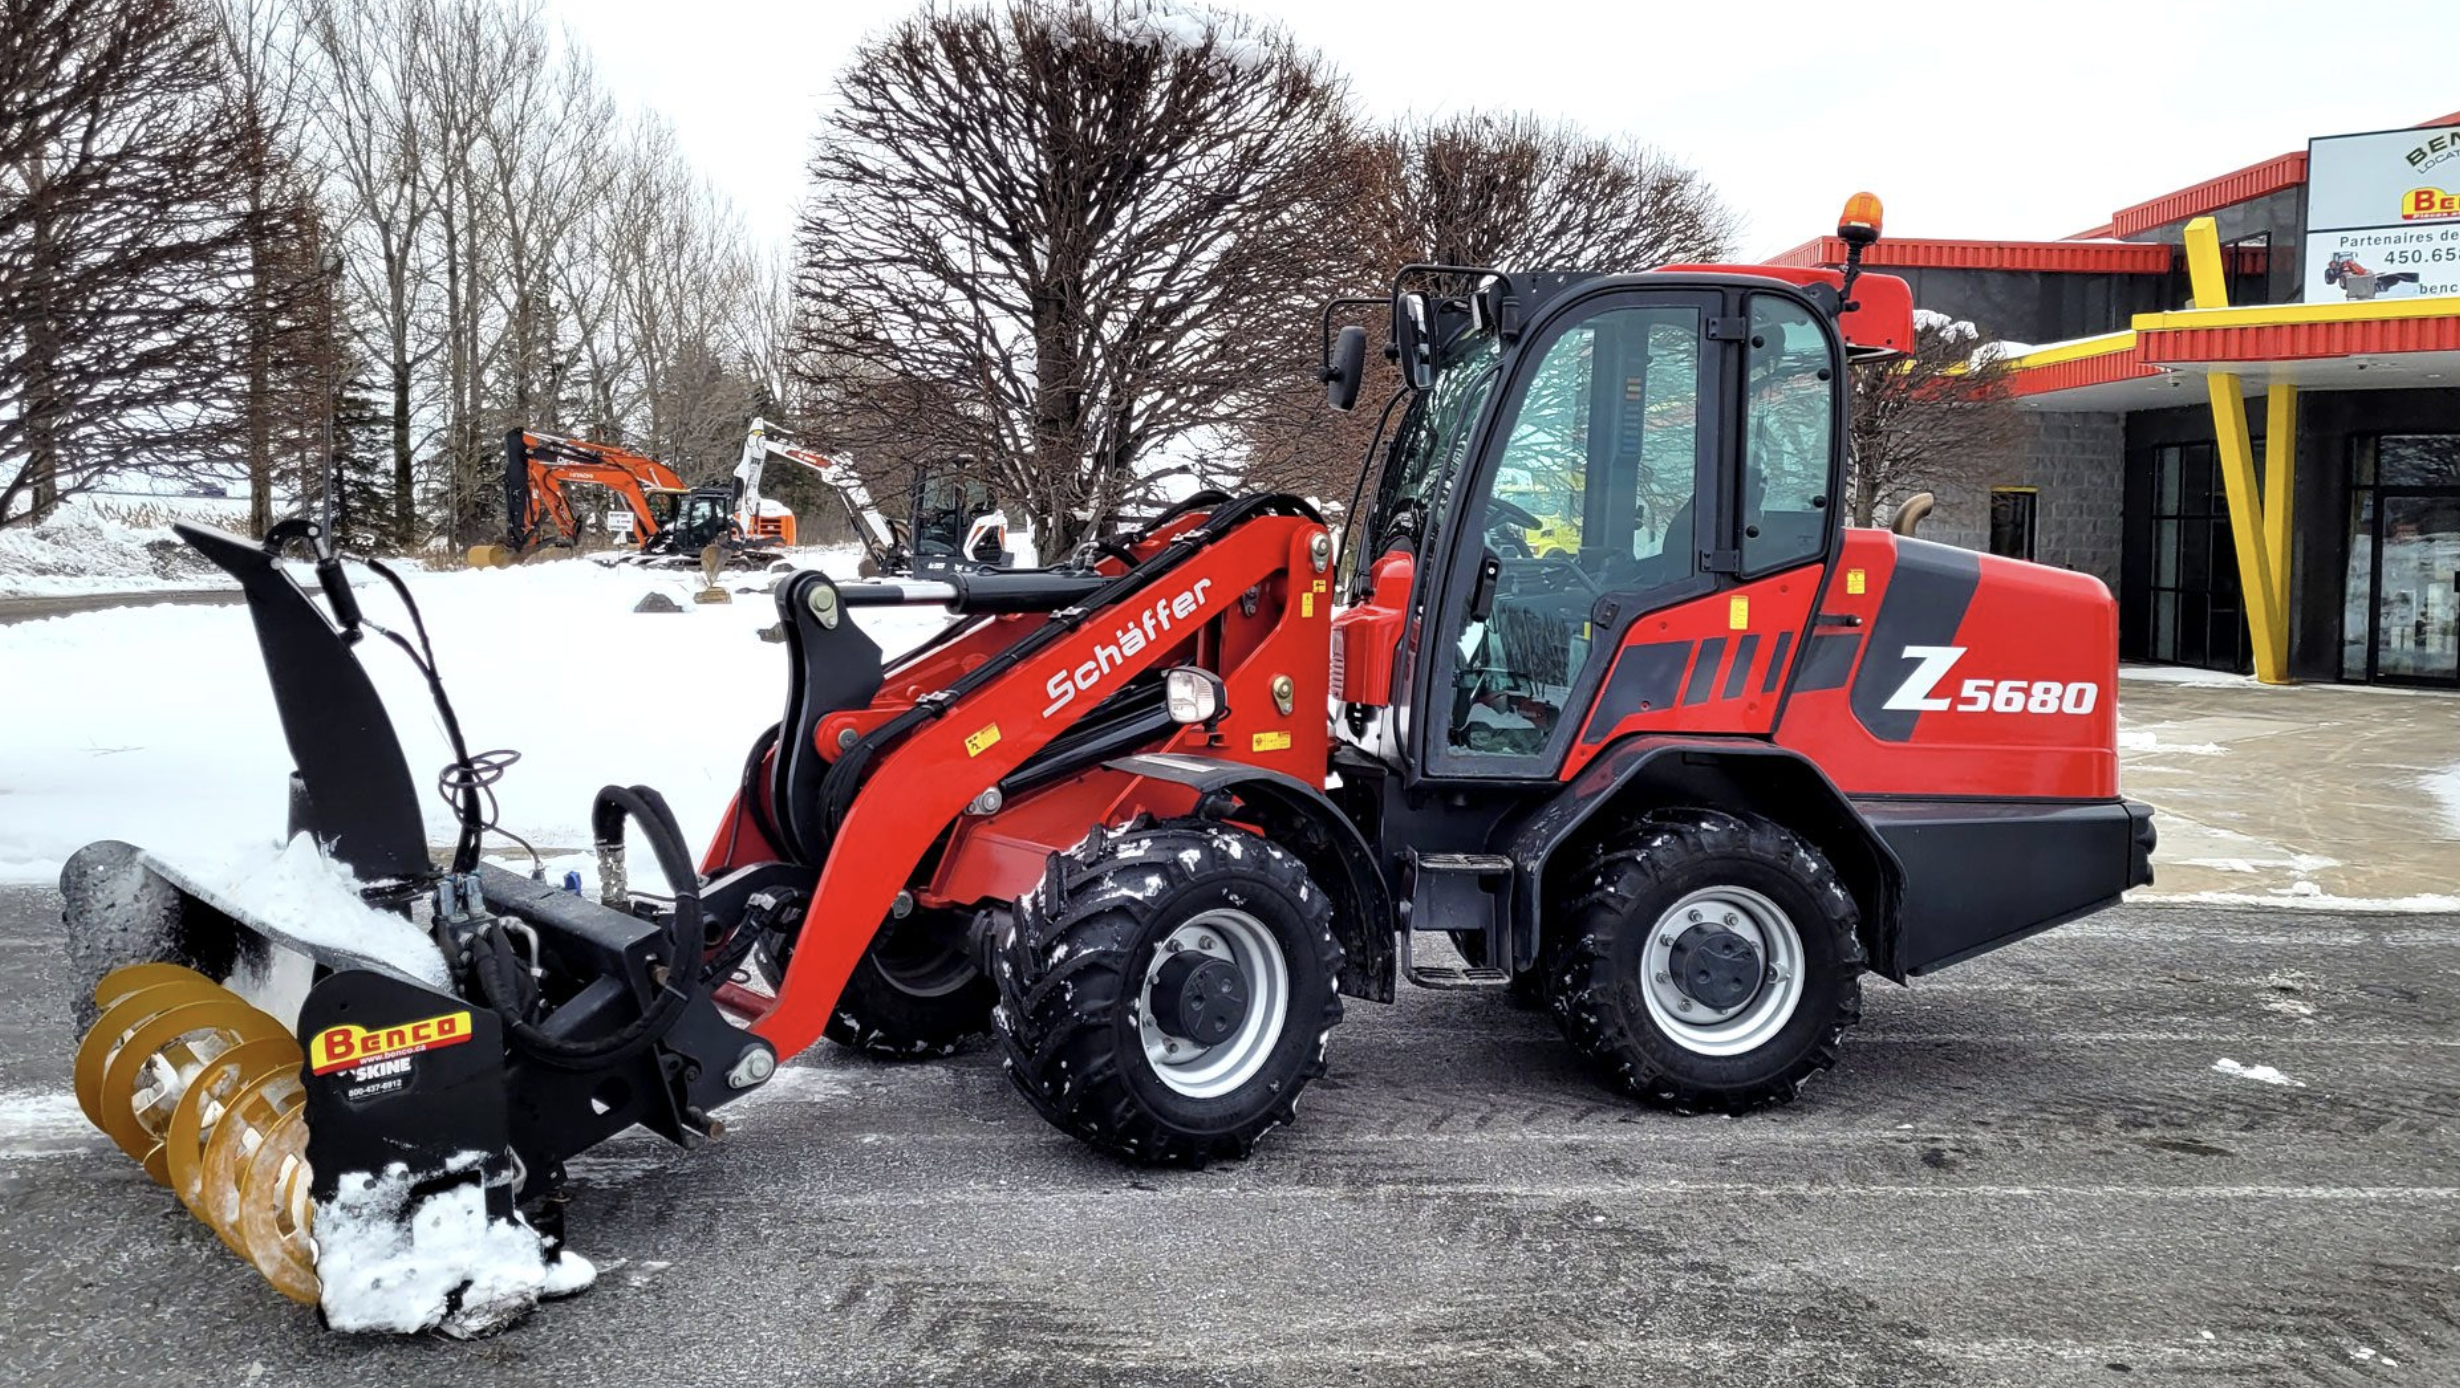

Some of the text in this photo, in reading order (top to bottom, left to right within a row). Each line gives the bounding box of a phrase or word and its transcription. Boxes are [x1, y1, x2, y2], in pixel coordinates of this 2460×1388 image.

[2340, 229, 2460, 248] Partenaires de
[2384, 247, 2460, 265] 450.65
[1042, 578, 1211, 718] Schäffer
[1881, 645, 2098, 714] Z 5680
[359, 1044, 427, 1065] www.benco.ca
[336, 1057, 411, 1082] SKINE
